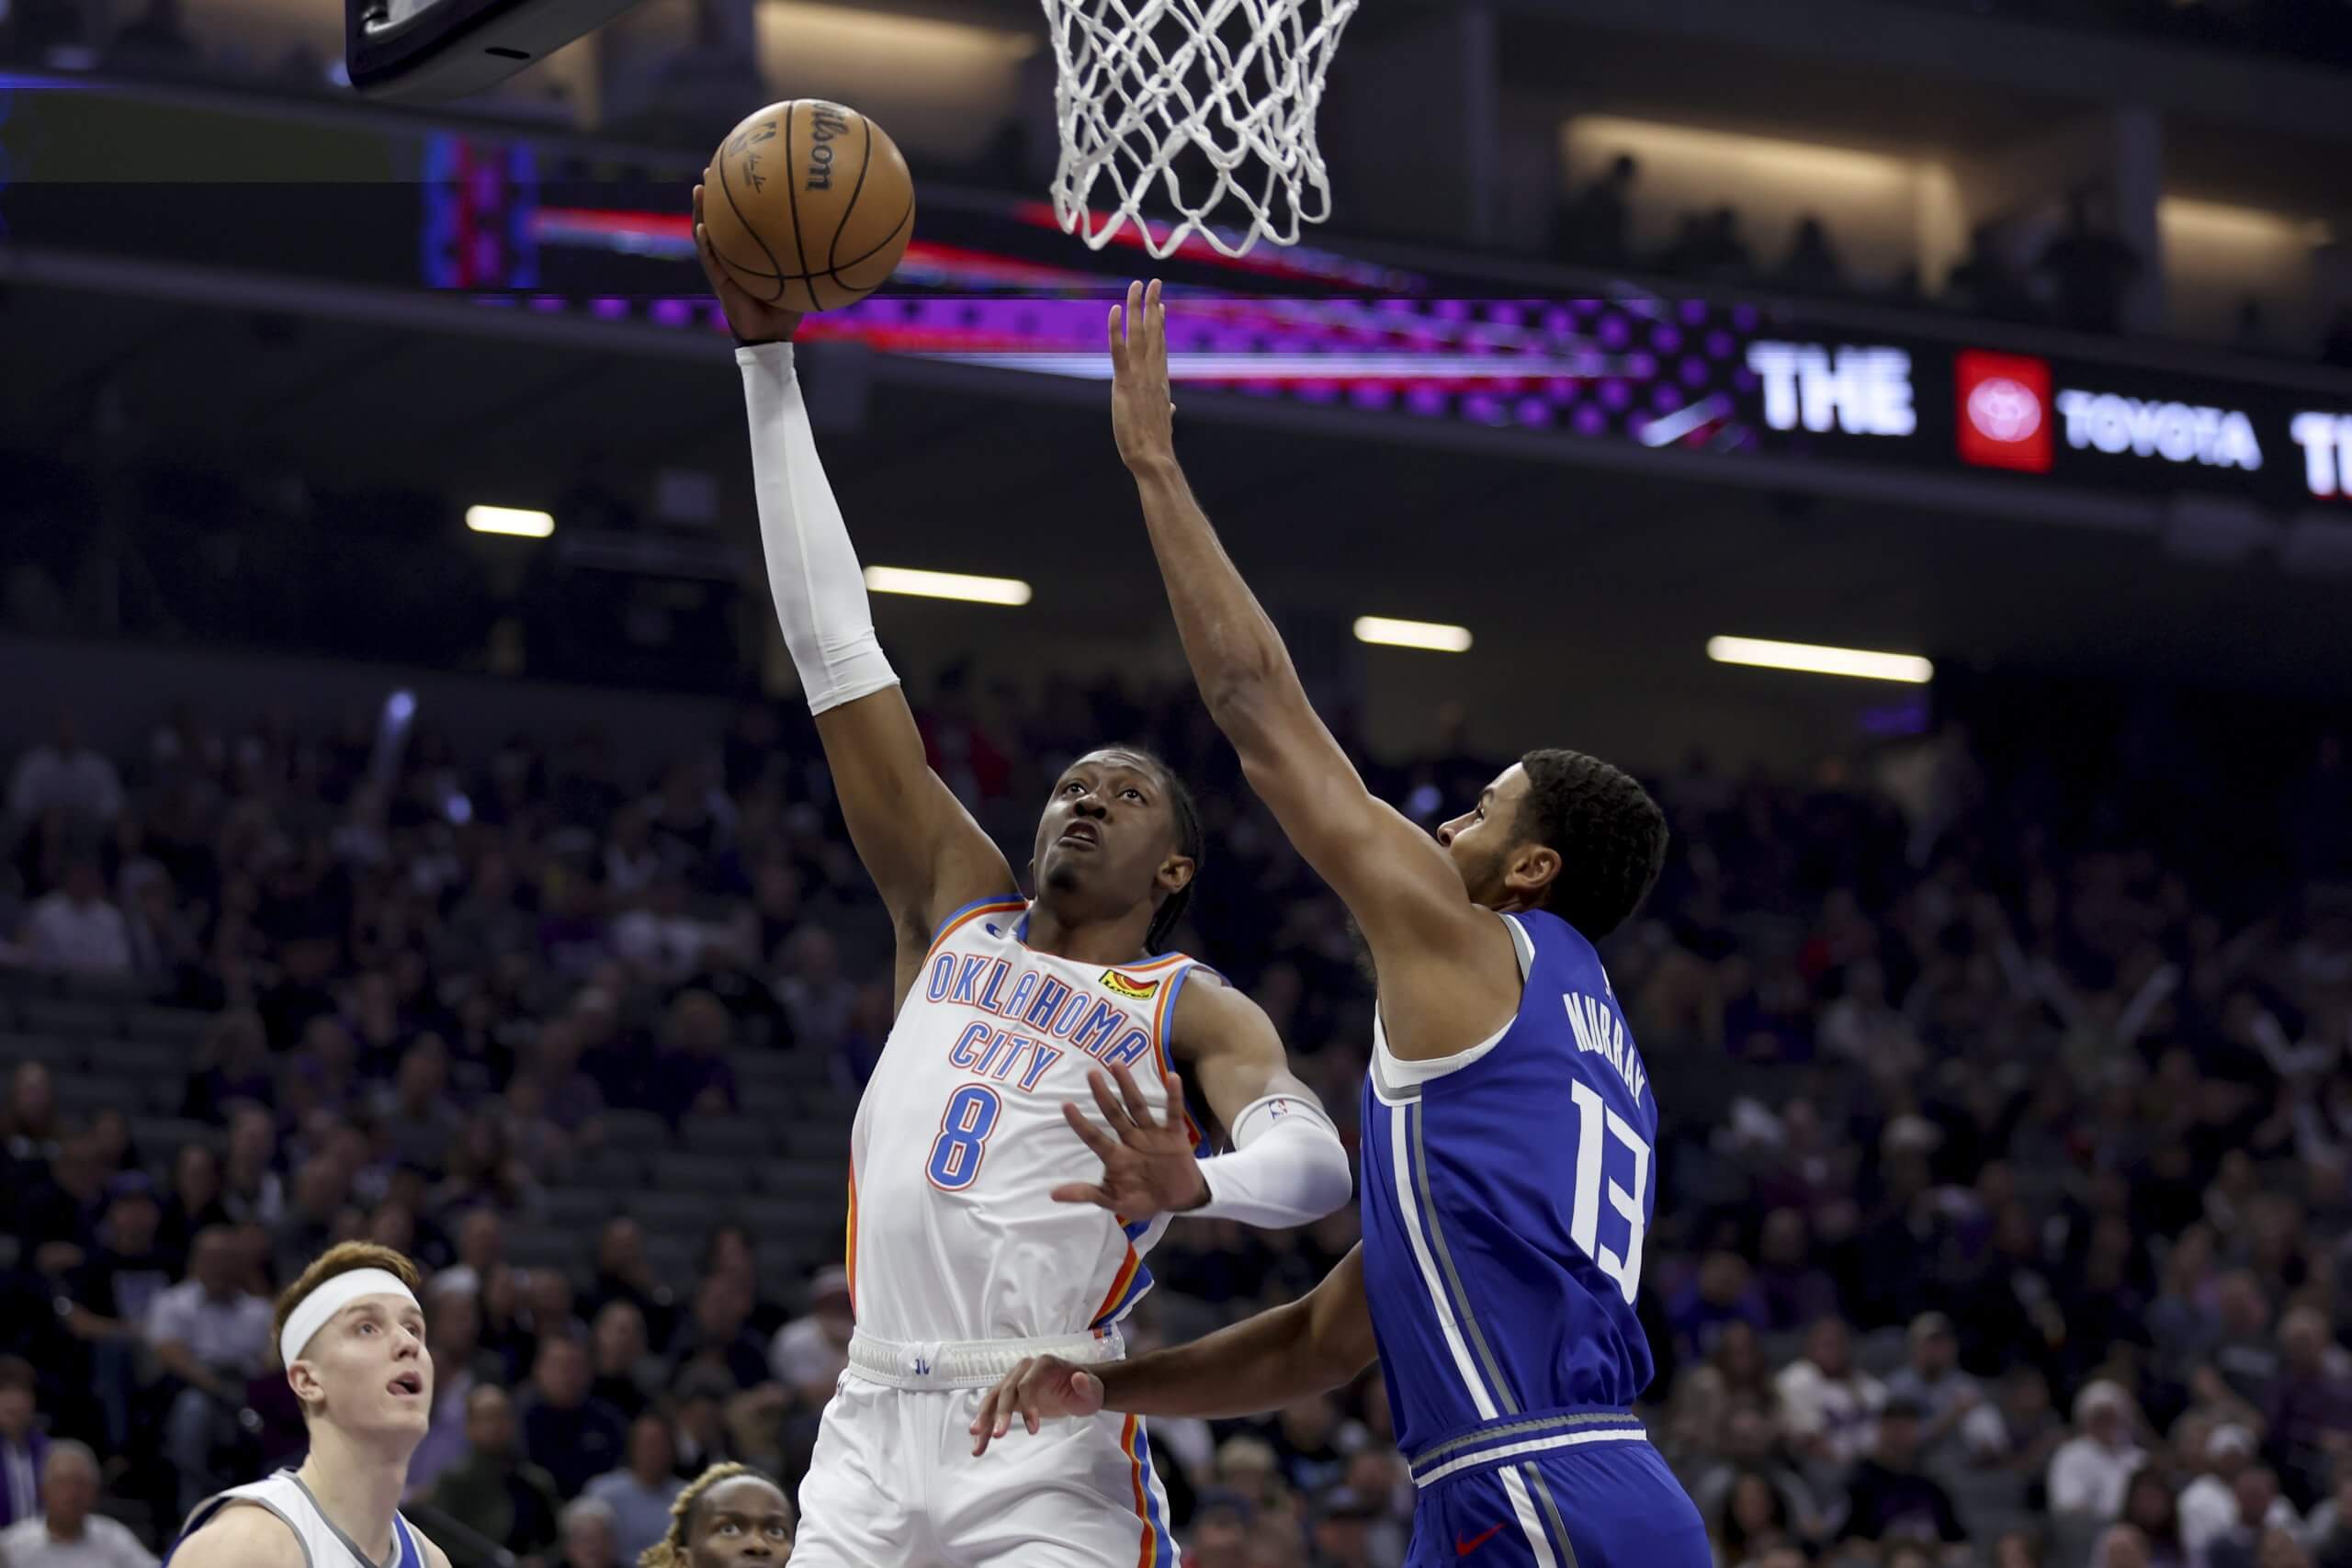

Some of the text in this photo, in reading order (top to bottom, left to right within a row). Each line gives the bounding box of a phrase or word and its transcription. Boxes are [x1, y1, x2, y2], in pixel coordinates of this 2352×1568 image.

[1747, 340, 1917, 435] THE
[2056, 389, 2262, 470] TOYOTA
[927, 953, 1150, 1071] OKLAHOMA
[950, 1021, 1064, 1092] CITY
[1563, 992, 1645, 1109] MURRAY
[926, 1083, 1001, 1191] 8
[1571, 1077, 1650, 1304] 13
